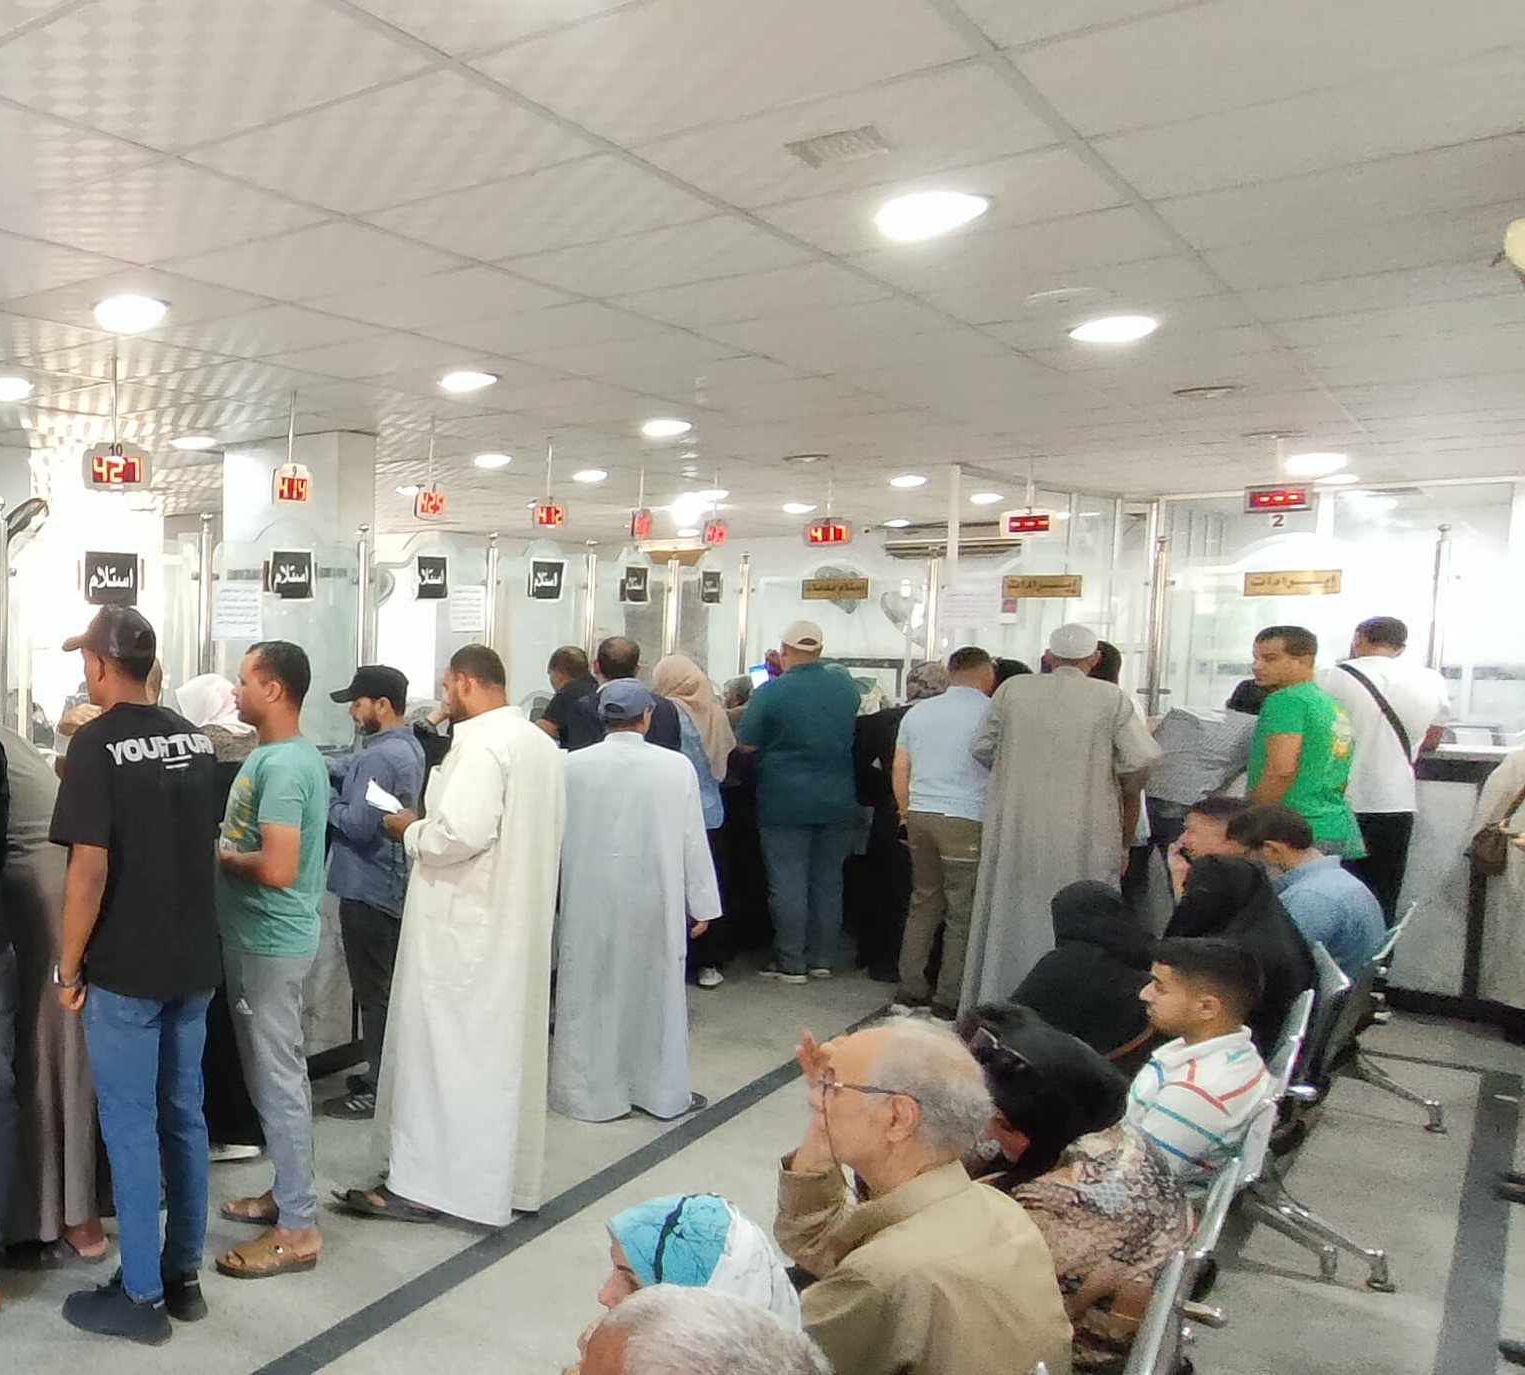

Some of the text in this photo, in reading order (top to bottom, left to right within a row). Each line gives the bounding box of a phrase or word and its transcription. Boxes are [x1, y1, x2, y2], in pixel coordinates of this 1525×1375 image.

[109, 443, 123, 456] 10
[92, 455, 140, 482] 427
[292, 465, 298, 477] 9
[1272, 514, 1284, 528] 2
[811, 526, 846, 543] 417
[88, 564, 134, 597] استلام
[274, 561, 309, 591] استلام
